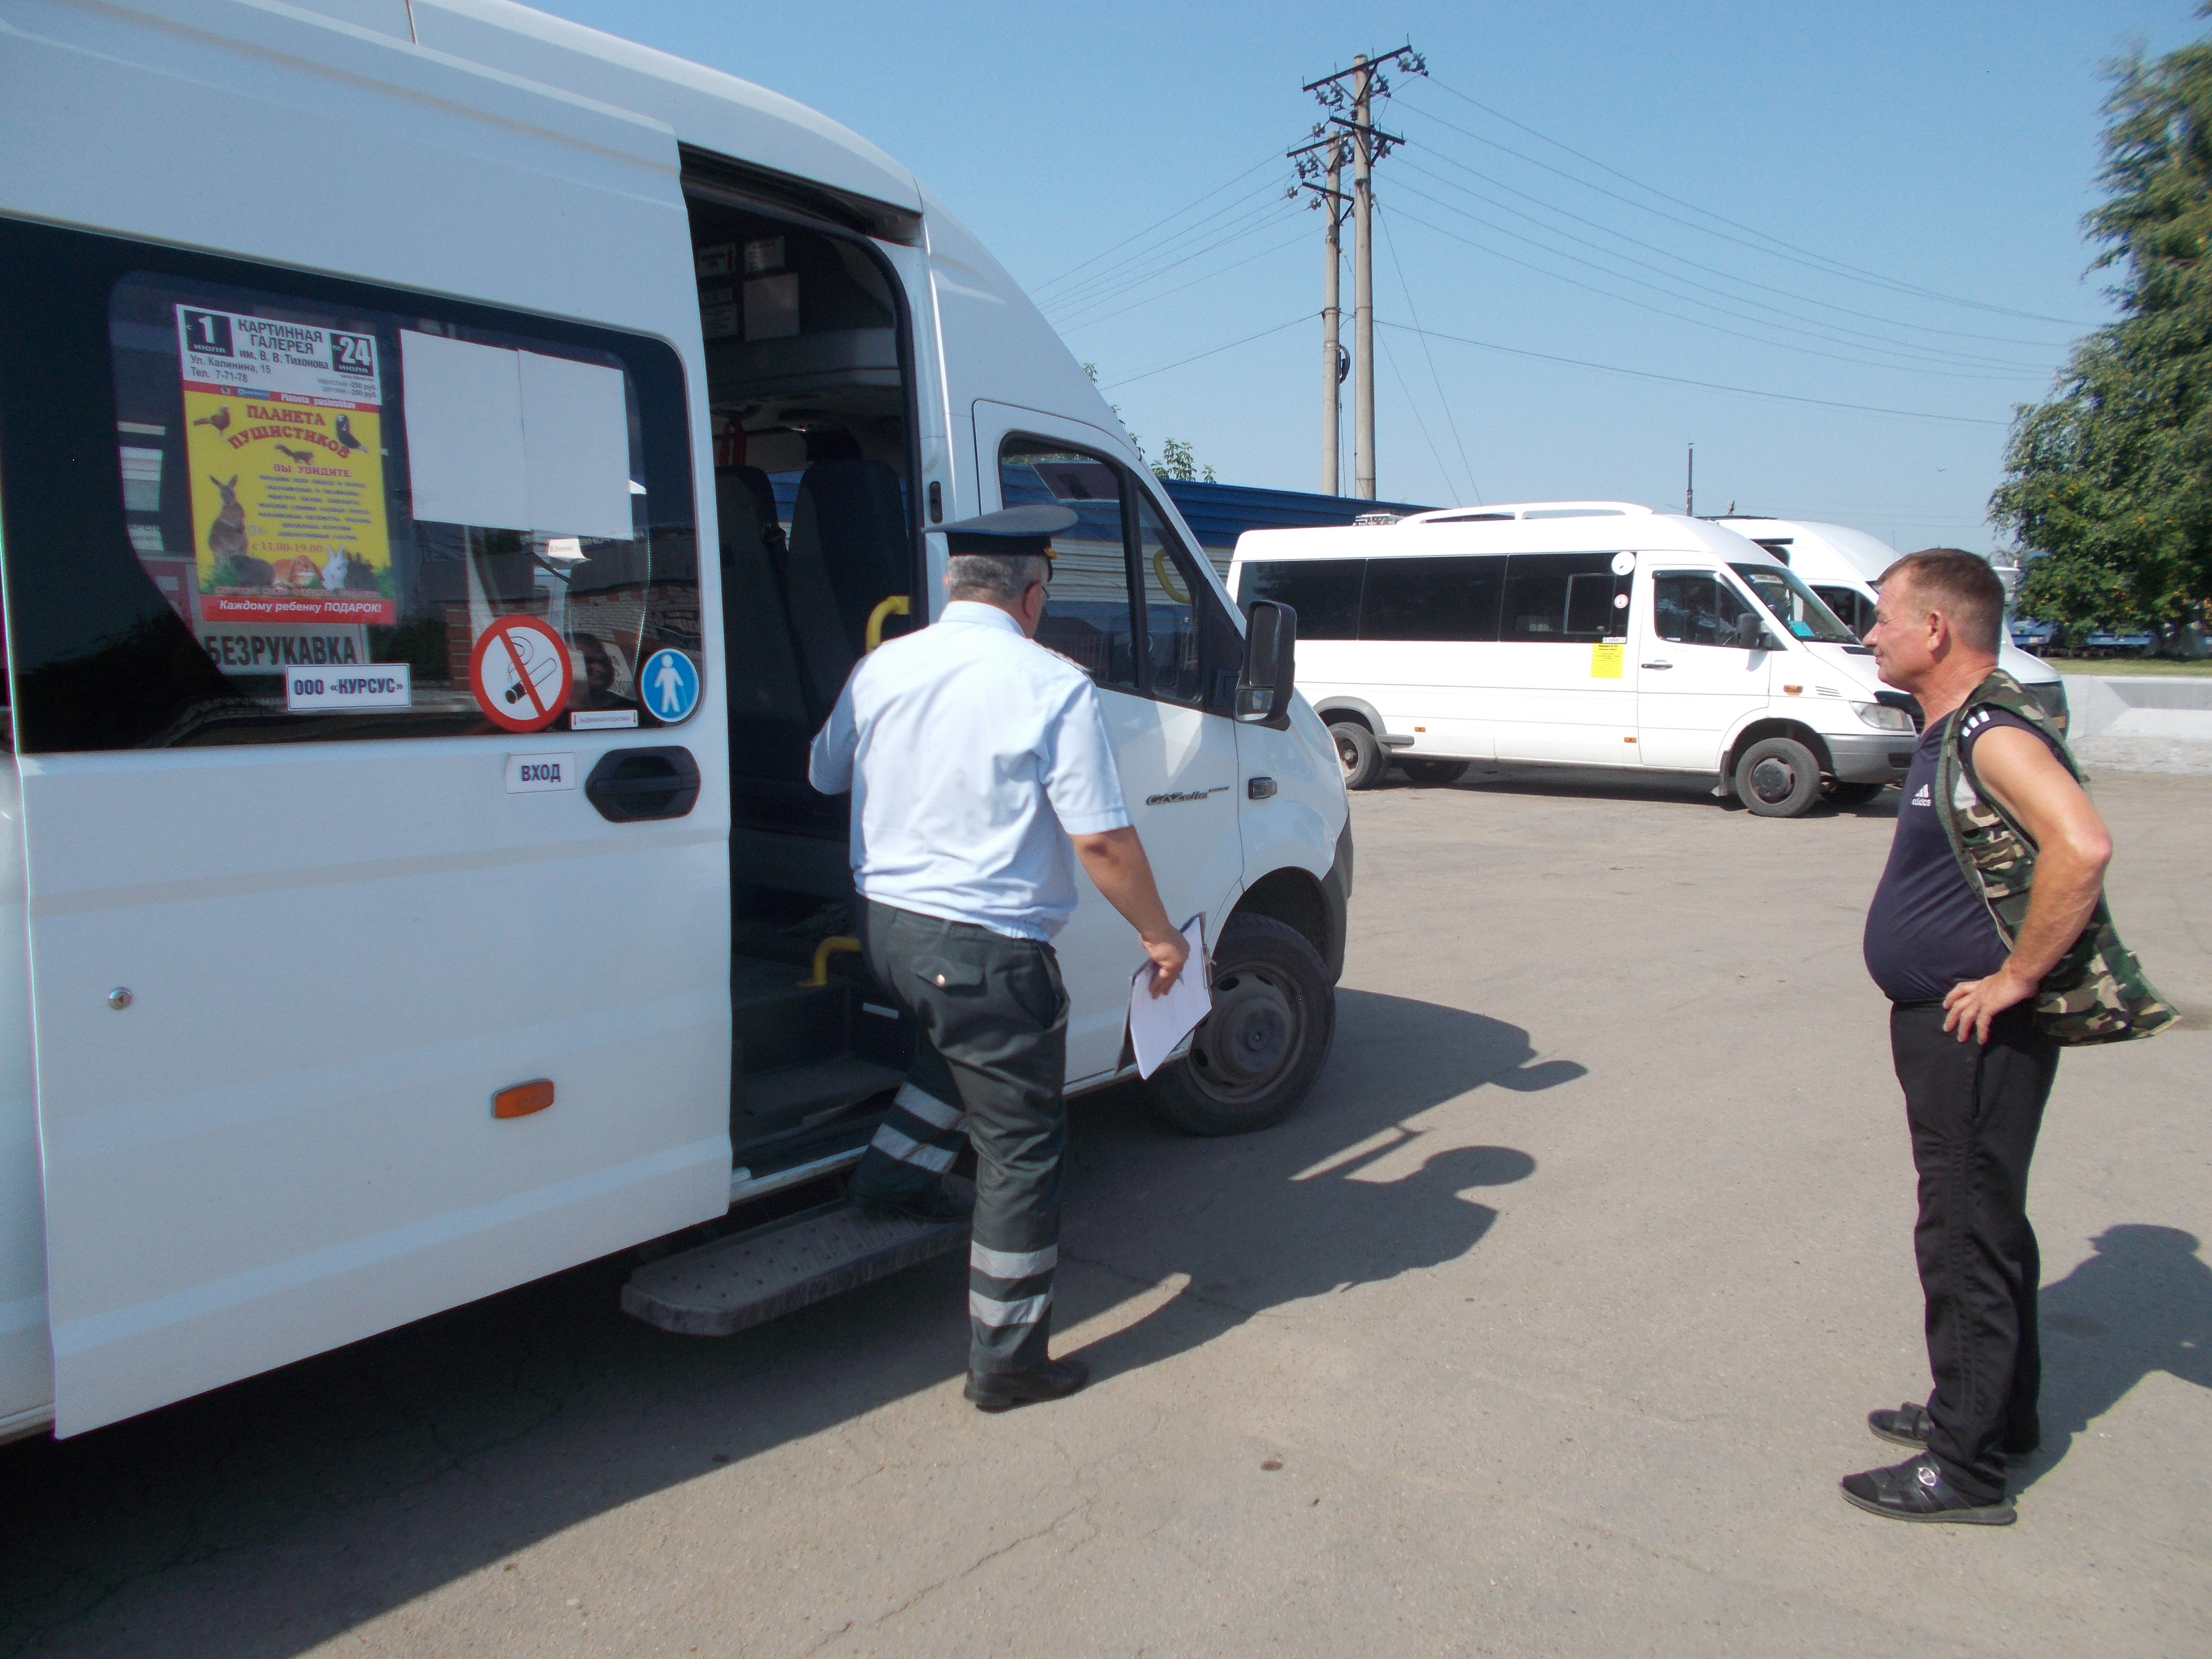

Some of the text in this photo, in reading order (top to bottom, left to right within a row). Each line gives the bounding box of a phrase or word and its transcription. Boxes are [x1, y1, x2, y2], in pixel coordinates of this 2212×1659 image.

[198, 315, 215, 344] 1
[238, 318, 323, 343] КАРТИННАЯ
[194, 344, 226, 353] июля
[250, 334, 314, 355] ГАЛЕРЕЯ
[340, 336, 371, 366] 24
[190, 354, 271, 374] Ул. Калинина, 15
[240, 350, 329, 370] им. В. В. Тихонова
[339, 364, 368, 373] июля
[191, 366, 248, 383] Тел. 7-71-78
[281, 392, 310, 404] Planeta
[314, 398, 356, 409] pushistikov
[247, 405, 326, 426] ПЛАНЕТА
[228, 425, 350, 459] ПУШИСТИКОВ
[273, 463, 291, 473] ВЫ
[220, 600, 381, 614] Каждому ребенку ПОДАРОК!
[204, 636, 358, 665] БЕЗРУКАВКА
[294, 677, 403, 696] ООО «КУРСУС»
[521, 763, 561, 783] ВХОД
[1146, 792, 1208, 805] GAZelle
[1912, 797, 1931, 806] adidas
